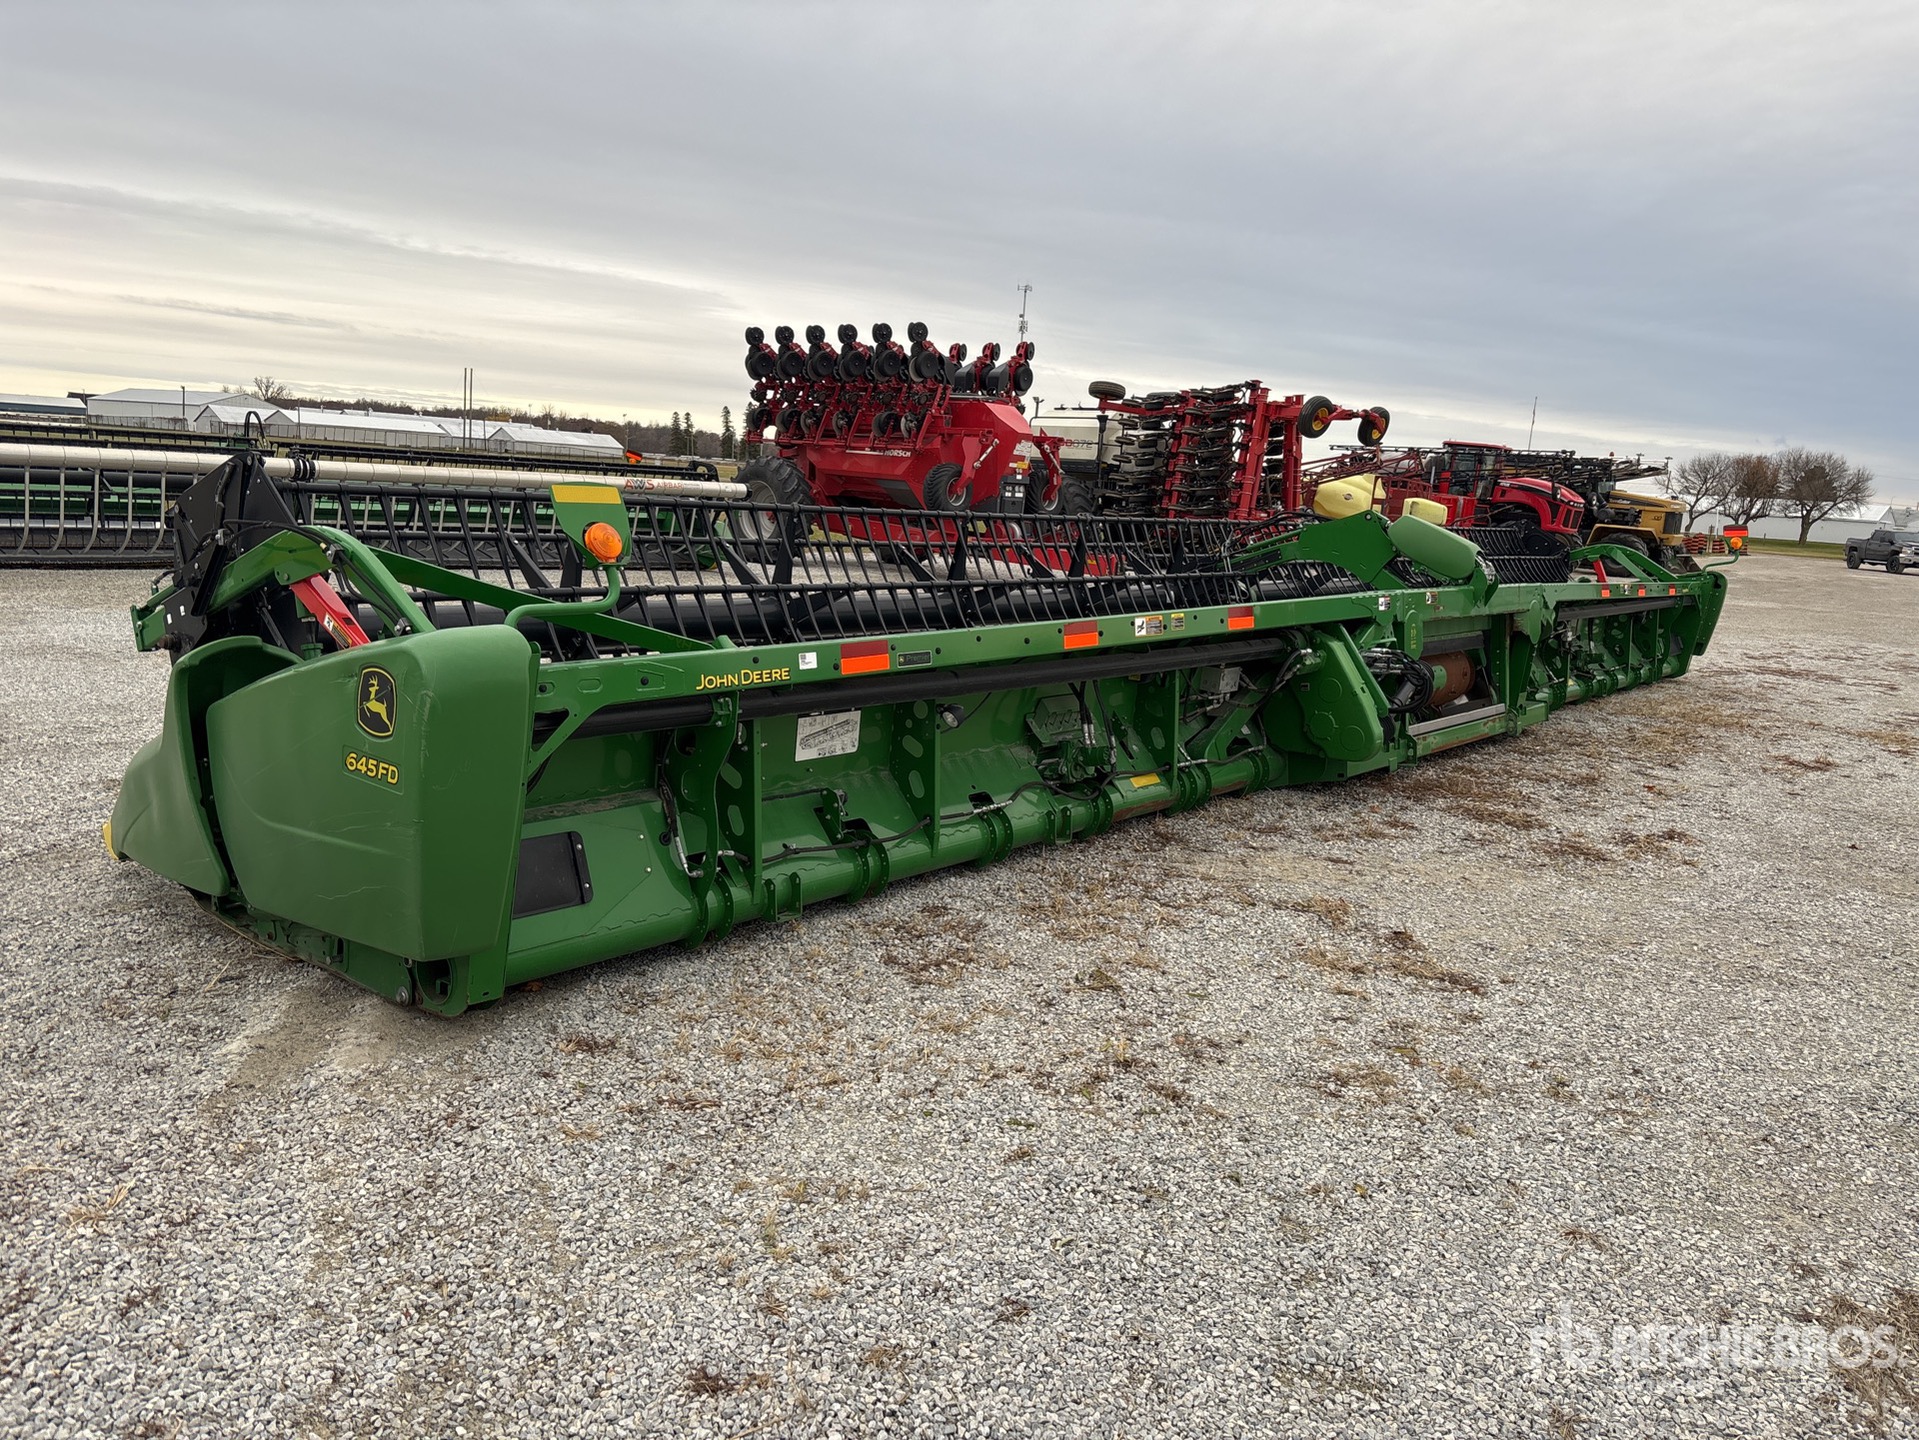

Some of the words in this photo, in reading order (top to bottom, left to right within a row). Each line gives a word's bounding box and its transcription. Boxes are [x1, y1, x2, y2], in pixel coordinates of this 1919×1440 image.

[884, 449, 911, 457] HORSCH
[624, 479, 655, 491] AWS
[696, 673, 739, 691] JOHN
[740, 667, 791, 685] DEERE
[345, 752, 399, 784] 645FD
